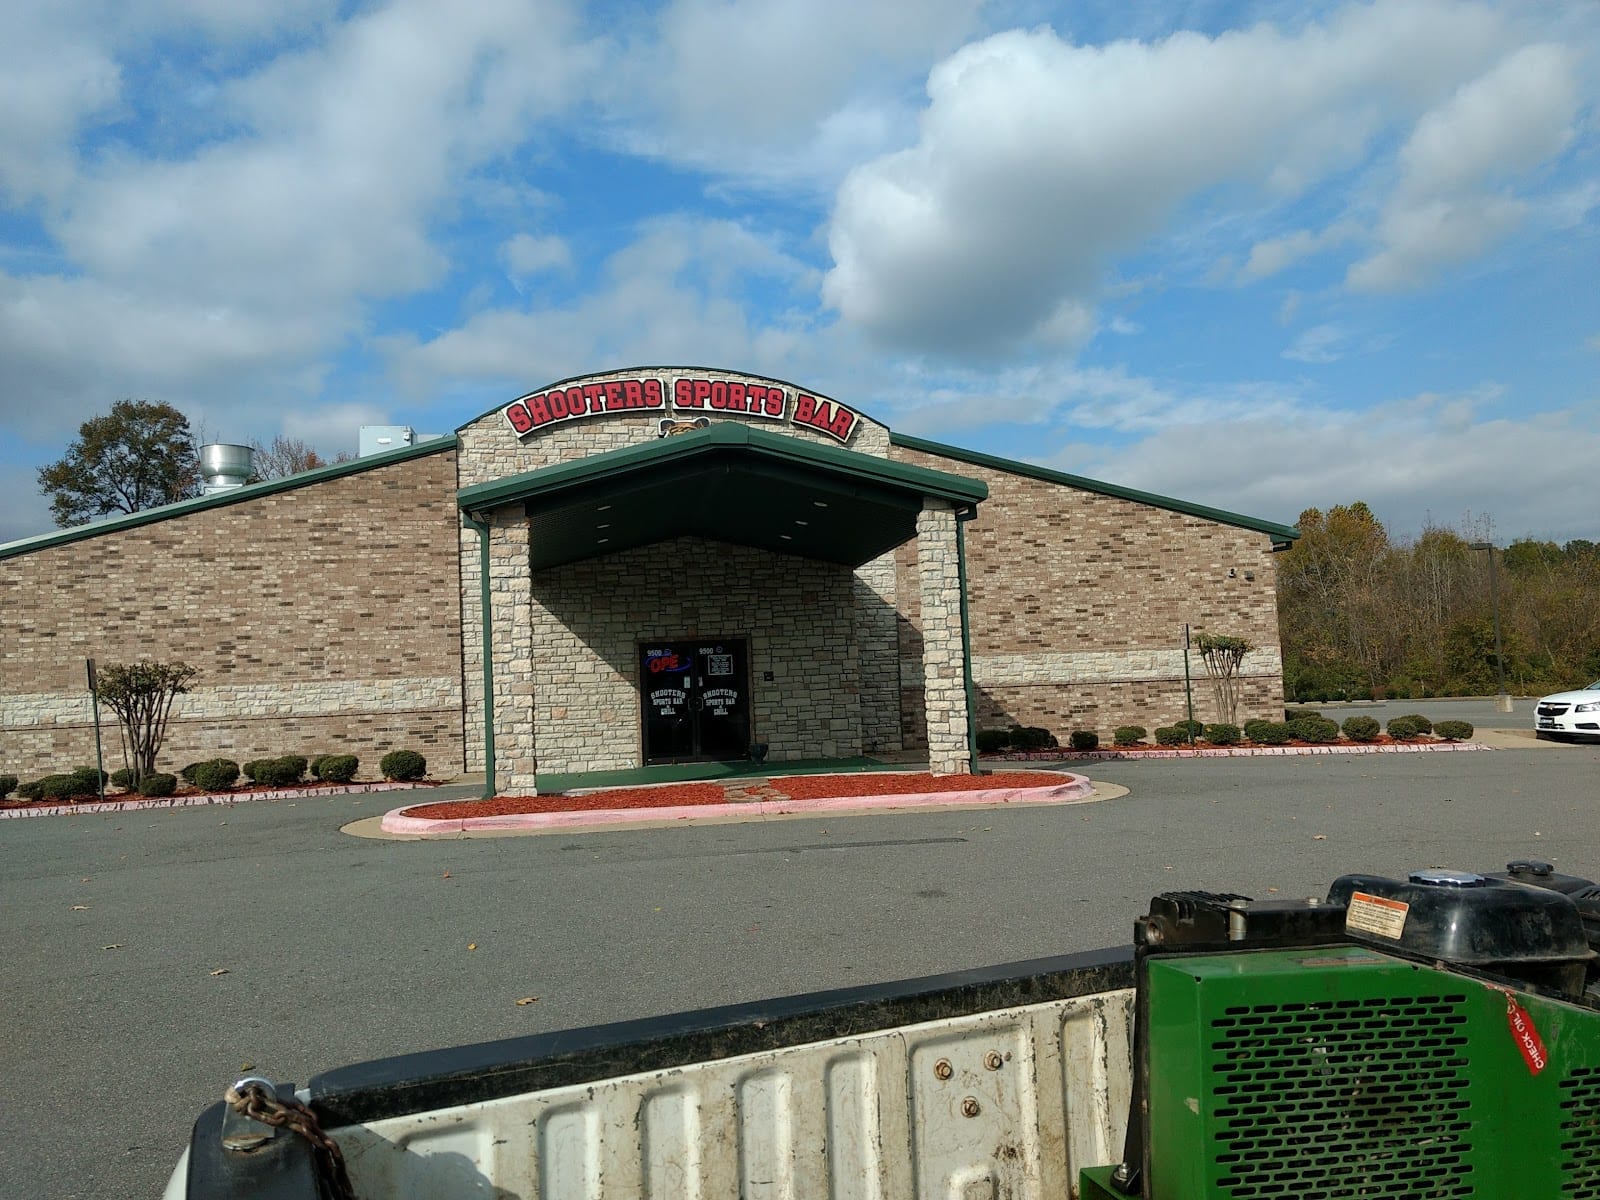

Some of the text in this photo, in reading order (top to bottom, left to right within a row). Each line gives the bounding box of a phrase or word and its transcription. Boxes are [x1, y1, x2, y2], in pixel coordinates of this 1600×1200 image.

[506, 379, 855, 440] SHOOTERS SPORTS BAR
[651, 689, 686, 699] SHOOTERS
[703, 689, 737, 699] SHOOTERS
[1514, 1013, 1544, 1069] CHECK OIL
